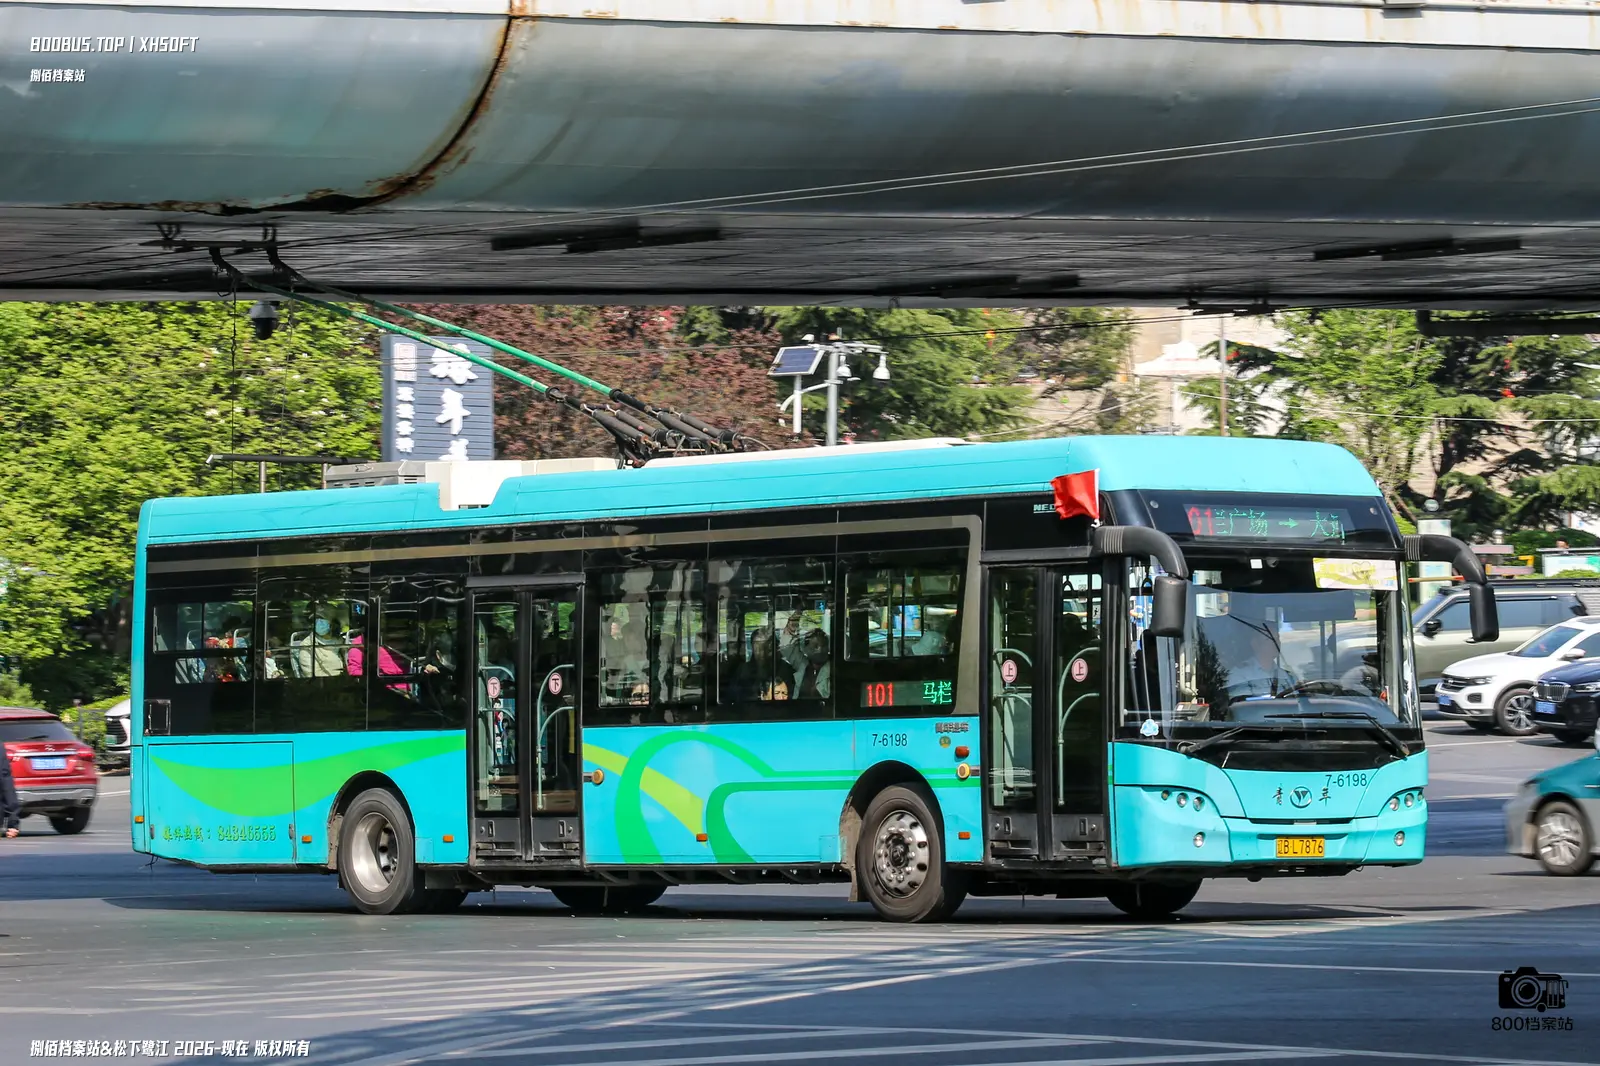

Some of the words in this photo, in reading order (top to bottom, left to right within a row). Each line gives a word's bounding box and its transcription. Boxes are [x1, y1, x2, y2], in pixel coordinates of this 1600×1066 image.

[866, 682, 893, 707] 101
[922, 680, 953, 705] 马栏
[871, 733, 908, 747] 7-6198
[1325, 773, 1368, 788] 7-6198
[1318, 786, 1332, 806] 年
